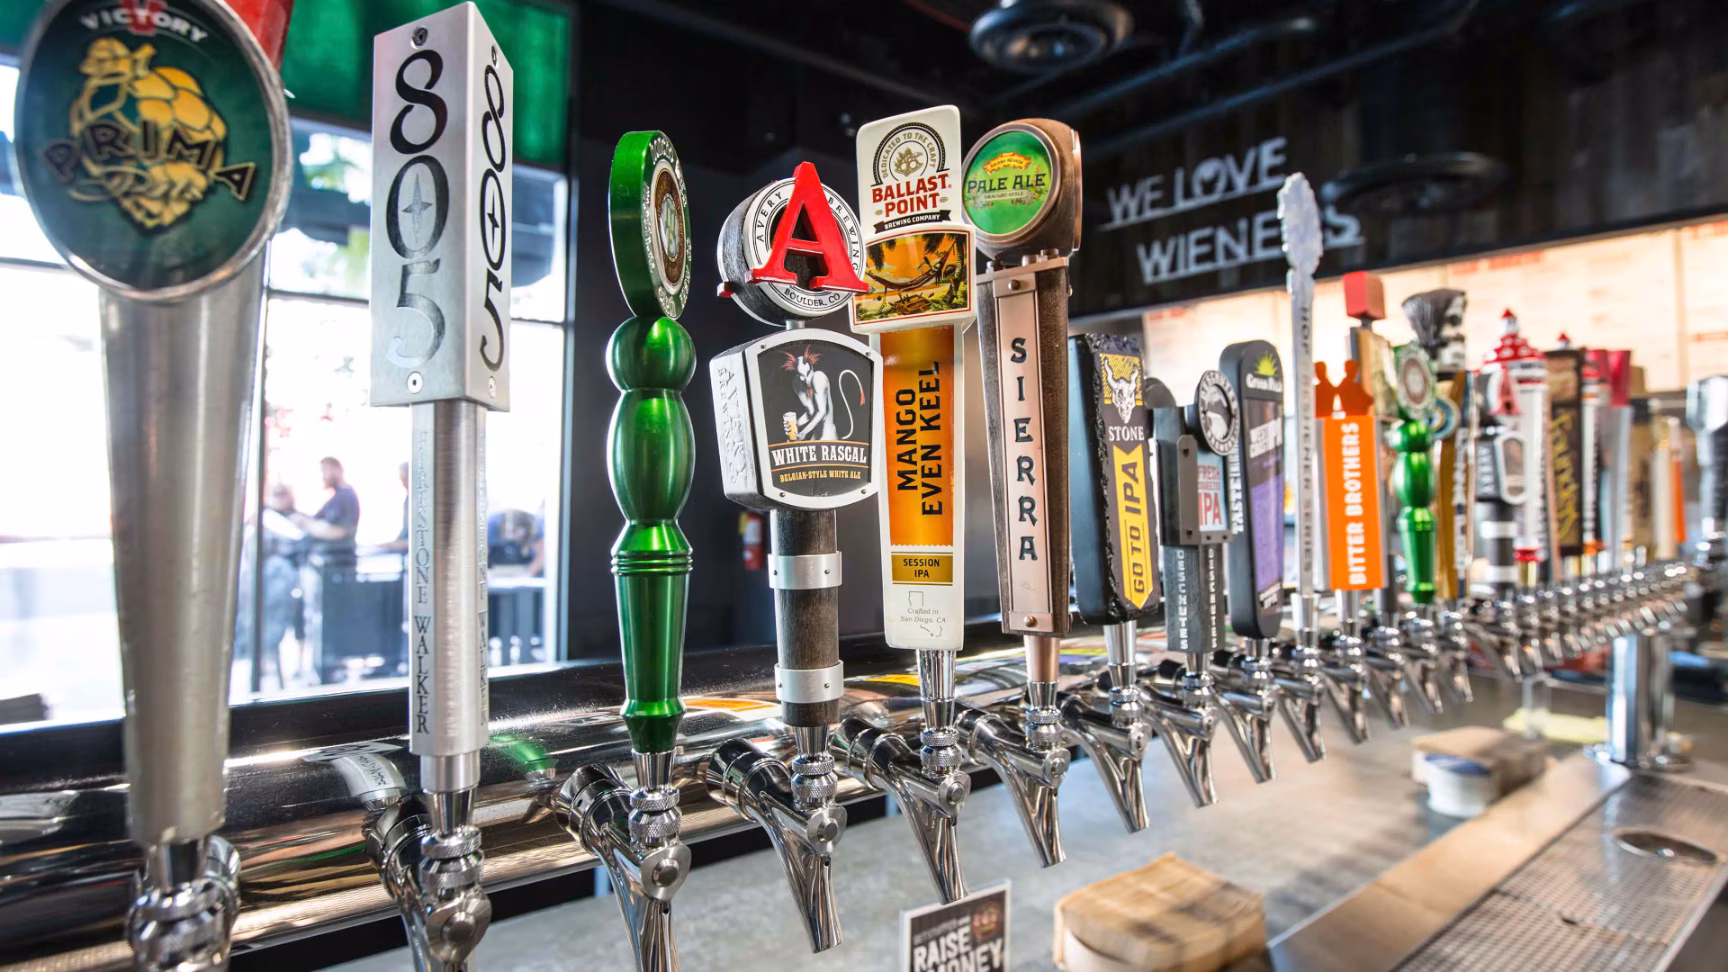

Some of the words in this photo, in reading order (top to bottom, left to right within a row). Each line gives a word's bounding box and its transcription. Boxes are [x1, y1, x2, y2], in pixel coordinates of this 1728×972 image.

[80, 6, 208, 43] VICTORY
[43, 119, 257, 200] PRIMA
[882, 136, 901, 179] DEDICATED
[902, 132, 912, 140] TO
[914, 132, 928, 144] THE
[926, 142, 937, 169] CRAFT
[872, 173, 949, 203] BALLAST
[968, 177, 1008, 194] PALE
[1013, 172, 1047, 190] ALE
[1107, 175, 1164, 224] WE
[1174, 136, 1288, 207] LOVE
[386, 49, 450, 368] 805
[479, 64, 507, 371] 805
[884, 219, 911, 230] BREWING
[912, 214, 941, 223] COMPANY
[885, 193, 940, 217] POINT
[757, 191, 783, 243] AVERY
[828, 197, 861, 272] BREWING
[1137, 188, 1363, 284] WIENES
[828, 292, 841, 304] CO
[918, 360, 942, 432] KEEL
[771, 445, 817, 467] WHITE
[820, 444, 867, 464] RASCAL
[895, 388, 918, 491] MANGO
[1010, 337, 1038, 561] SIERRA
[1108, 425, 1145, 442] STONE
[780, 470, 827, 482] BELGIAN-STYLE
[829, 469, 849, 479] WHITE
[849, 470, 861, 480] ALE
[921, 443, 943, 516] EVEN
[1121, 460, 1142, 516] IPA
[1341, 421, 1364, 517] BROTHERS
[1197, 492, 1223, 526] IPA
[903, 558, 940, 567] SESSION
[1130, 525, 1142, 556] TO
[1346, 522, 1367, 585] BITTER
[914, 569, 930, 578] IPA
[1133, 561, 1145, 594] GO
[907, 607, 931, 616] Crafted
[932, 607, 939, 615] in
[936, 616, 946, 624] CA
[1176, 549, 1189, 650] DESCHUTES
[1208, 548, 1218, 649] DESCHUTES
[413, 615, 432, 735] WALKER
[913, 925, 972, 972] RAISE
[928, 937, 1004, 972] ONEY
